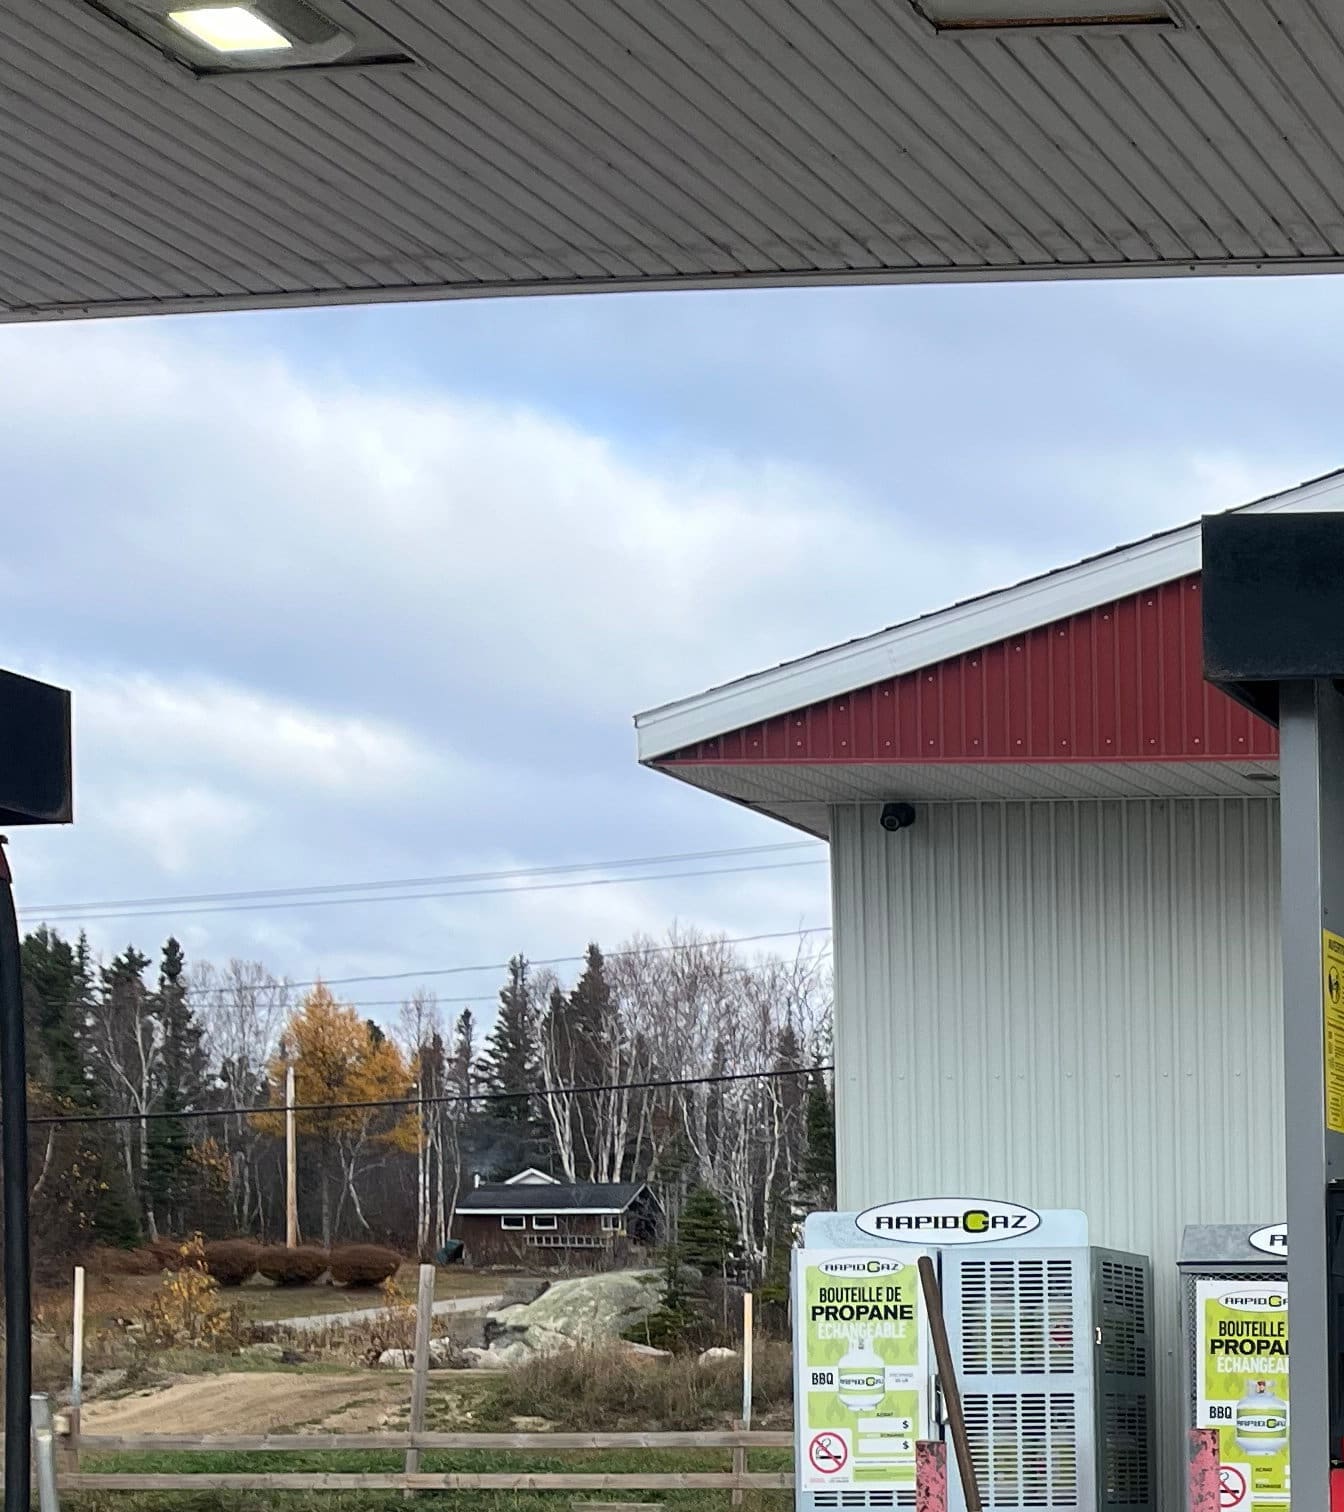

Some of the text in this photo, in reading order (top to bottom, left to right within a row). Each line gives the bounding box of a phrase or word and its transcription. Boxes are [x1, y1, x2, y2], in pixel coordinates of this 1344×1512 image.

[820, 1287, 902, 1303] BOUTEILLE DE
[811, 1305, 913, 1321] PROPANE
[1219, 1321, 1285, 1337] BOUTEILLE
[1210, 1339, 1289, 1355] PROPA
[1217, 1354, 1289, 1374] ÉCHANGEA
[812, 1372, 834, 1385] BBQ
[1209, 1406, 1232, 1419] BBQ
